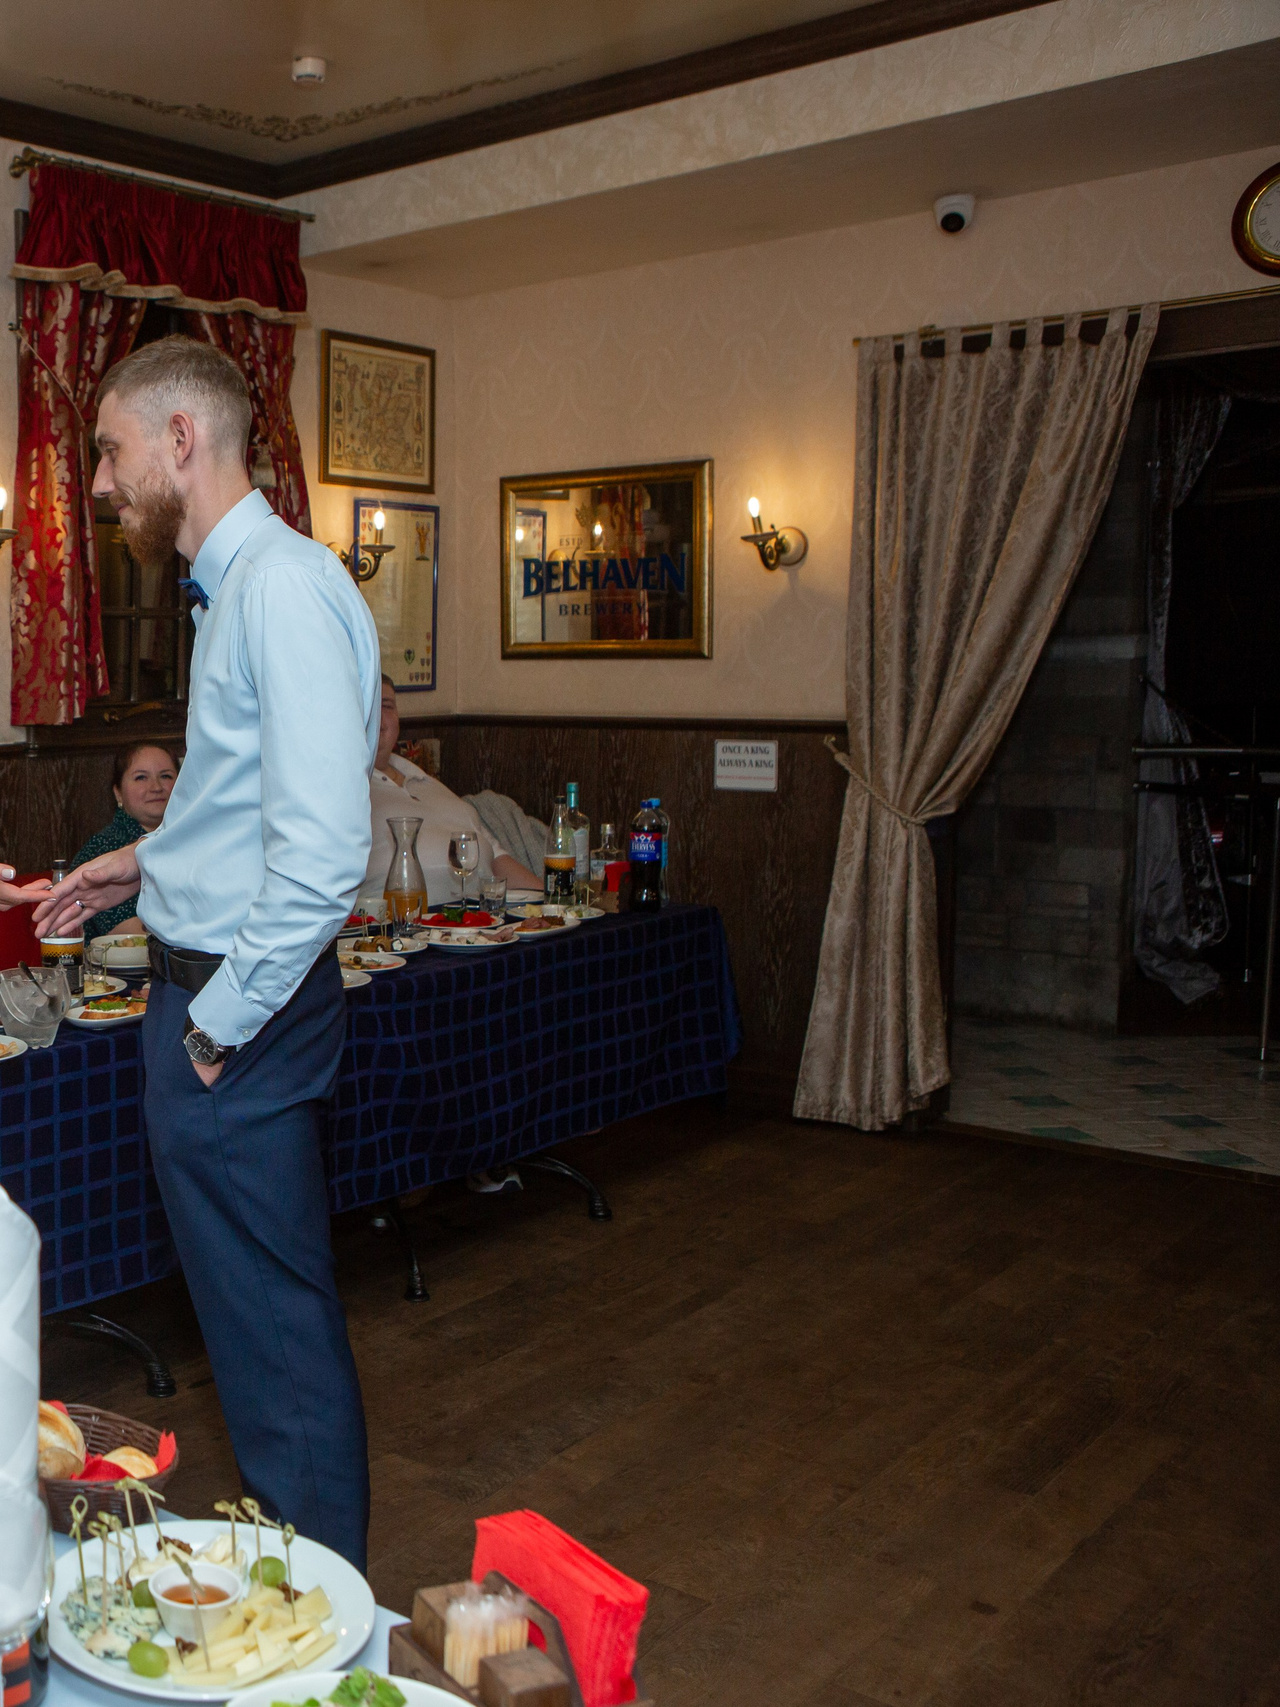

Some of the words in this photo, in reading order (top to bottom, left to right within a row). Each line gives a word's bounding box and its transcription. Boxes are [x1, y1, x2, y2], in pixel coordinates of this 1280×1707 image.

[523, 552, 686, 600] BELHAVEN
[559, 603, 646, 616] BREWERY
[722, 745, 742, 755] ONCE
[743, 745, 749, 755] A
